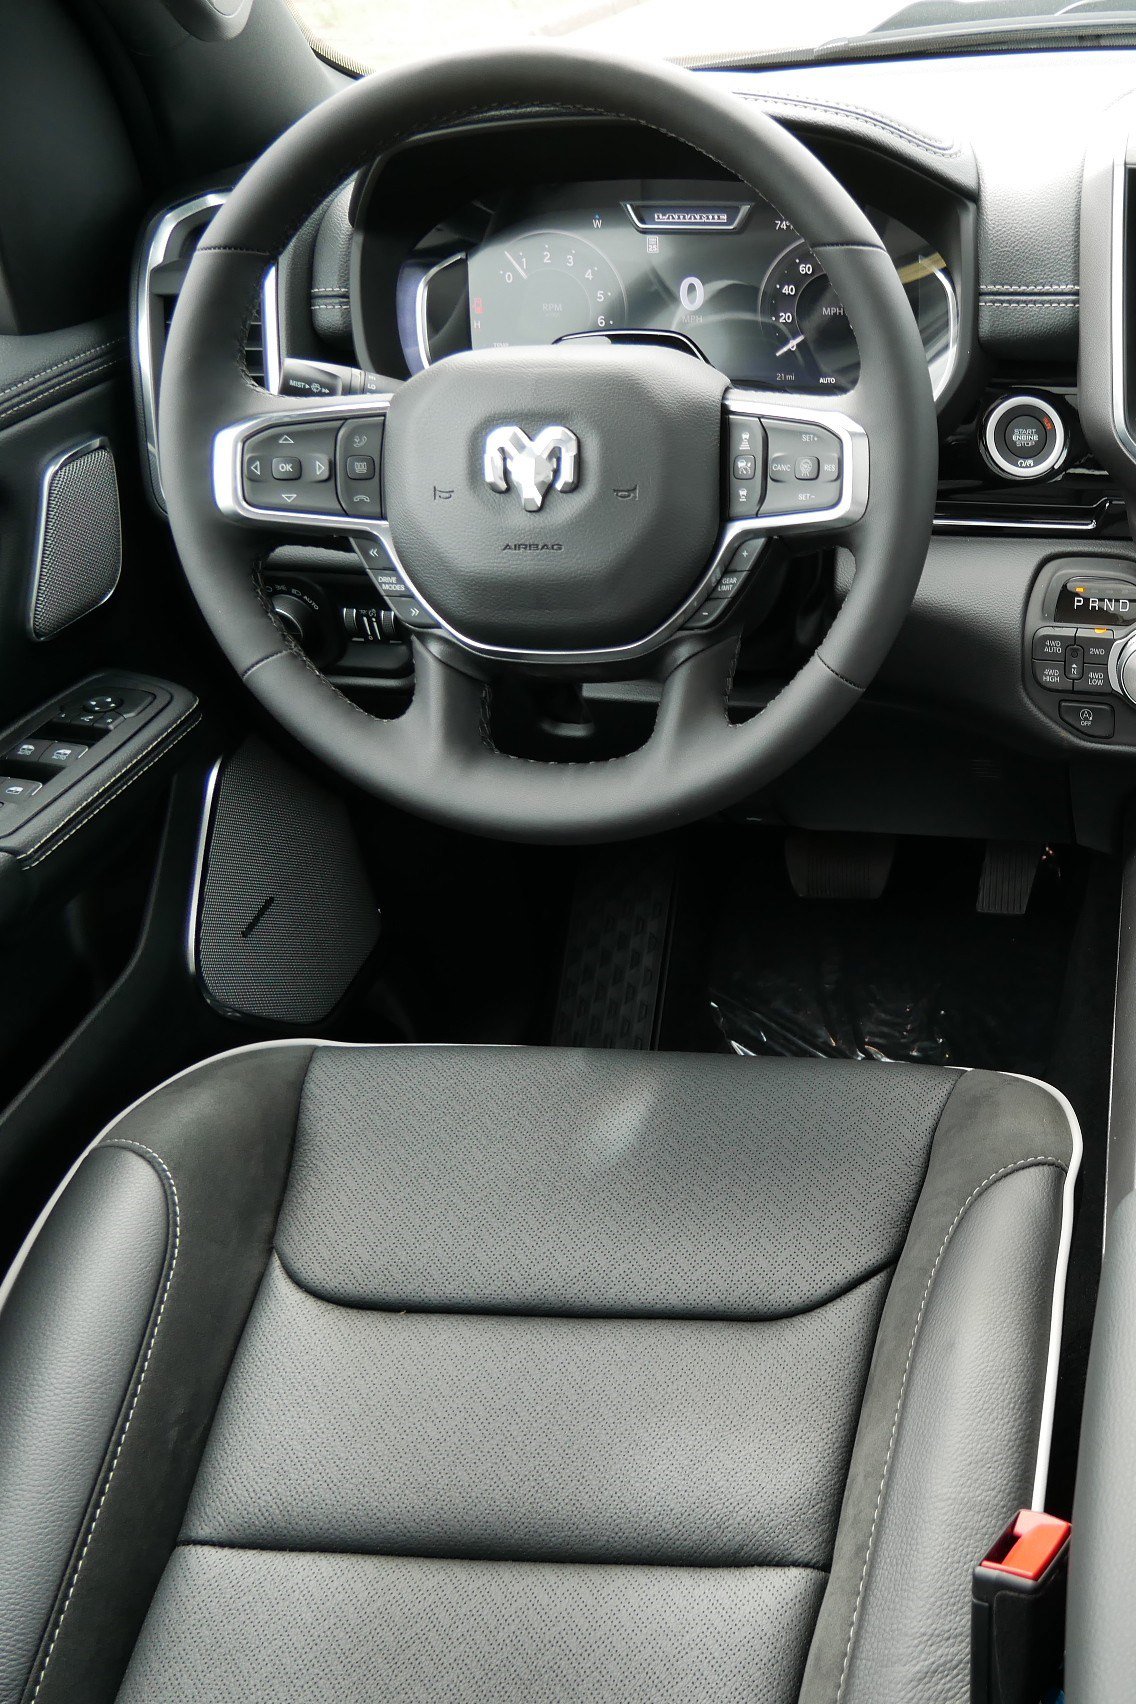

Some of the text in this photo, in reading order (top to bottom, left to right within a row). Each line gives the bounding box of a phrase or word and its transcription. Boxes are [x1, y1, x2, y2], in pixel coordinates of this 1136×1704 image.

[655, 213, 727, 222] LARAMIE
[593, 219, 602, 228] W
[544, 252, 551, 263] 2
[567, 255, 574, 266] 3
[522, 258, 527, 268] 1
[800, 264, 812, 274] 60
[506, 273, 513, 283] 0
[585, 269, 593, 280] 4
[680, 276, 704, 311] 0
[782, 286, 795, 295] 40
[597, 291, 604, 301] 5
[543, 304, 562, 312] RPM
[823, 308, 843, 316] MPH
[598, 316, 605, 326] 6
[682, 315, 703, 323] MPH
[780, 314, 792, 322] 20
[289, 380, 305, 388] MIST
[279, 463, 293, 472] OK
[502, 543, 564, 551] AIRBAG
[378, 576, 396, 584] DRIVE
[382, 583, 405, 591] MODES
[303, 595, 319, 610] AUTO
[1075, 598, 1129, 611] P R N D
[1043, 675, 1060, 683] HIGH
